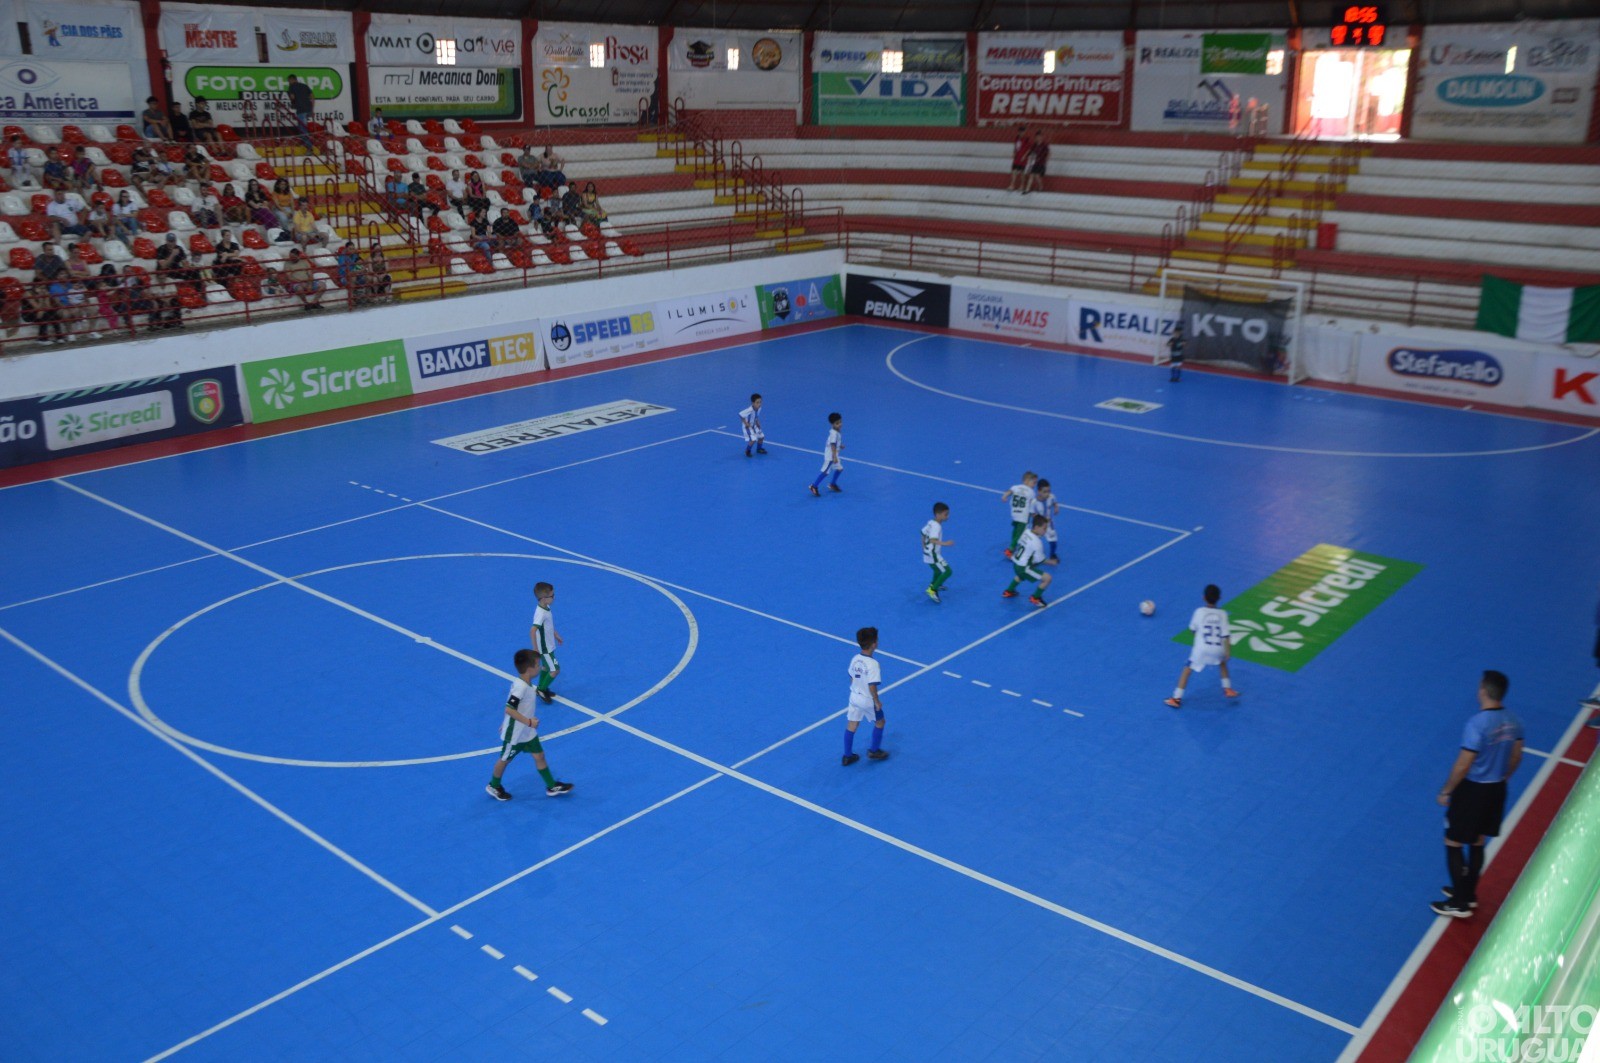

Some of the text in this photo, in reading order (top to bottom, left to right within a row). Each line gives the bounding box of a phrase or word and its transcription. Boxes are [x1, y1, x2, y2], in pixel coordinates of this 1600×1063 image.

[185, 30, 239, 48] MESTRE
[195, 76, 334, 91] FOTO CHPA
[243, 91, 290, 100] DIGITA
[847, 73, 962, 107] VIDA
[980, 77, 1032, 90] Centro
[1054, 77, 1121, 92] Pinturas
[23, 92, 99, 110] América
[547, 83, 610, 118] Girassol
[990, 93, 1105, 116] RENNER
[864, 300, 925, 322] PENALTY
[1191, 313, 1268, 343] KTO
[301, 355, 397, 398] Sicredi
[1395, 350, 1500, 382] Stefanello
[88, 402, 162, 433] Sicredi
[1259, 555, 1387, 627] Sicredi
